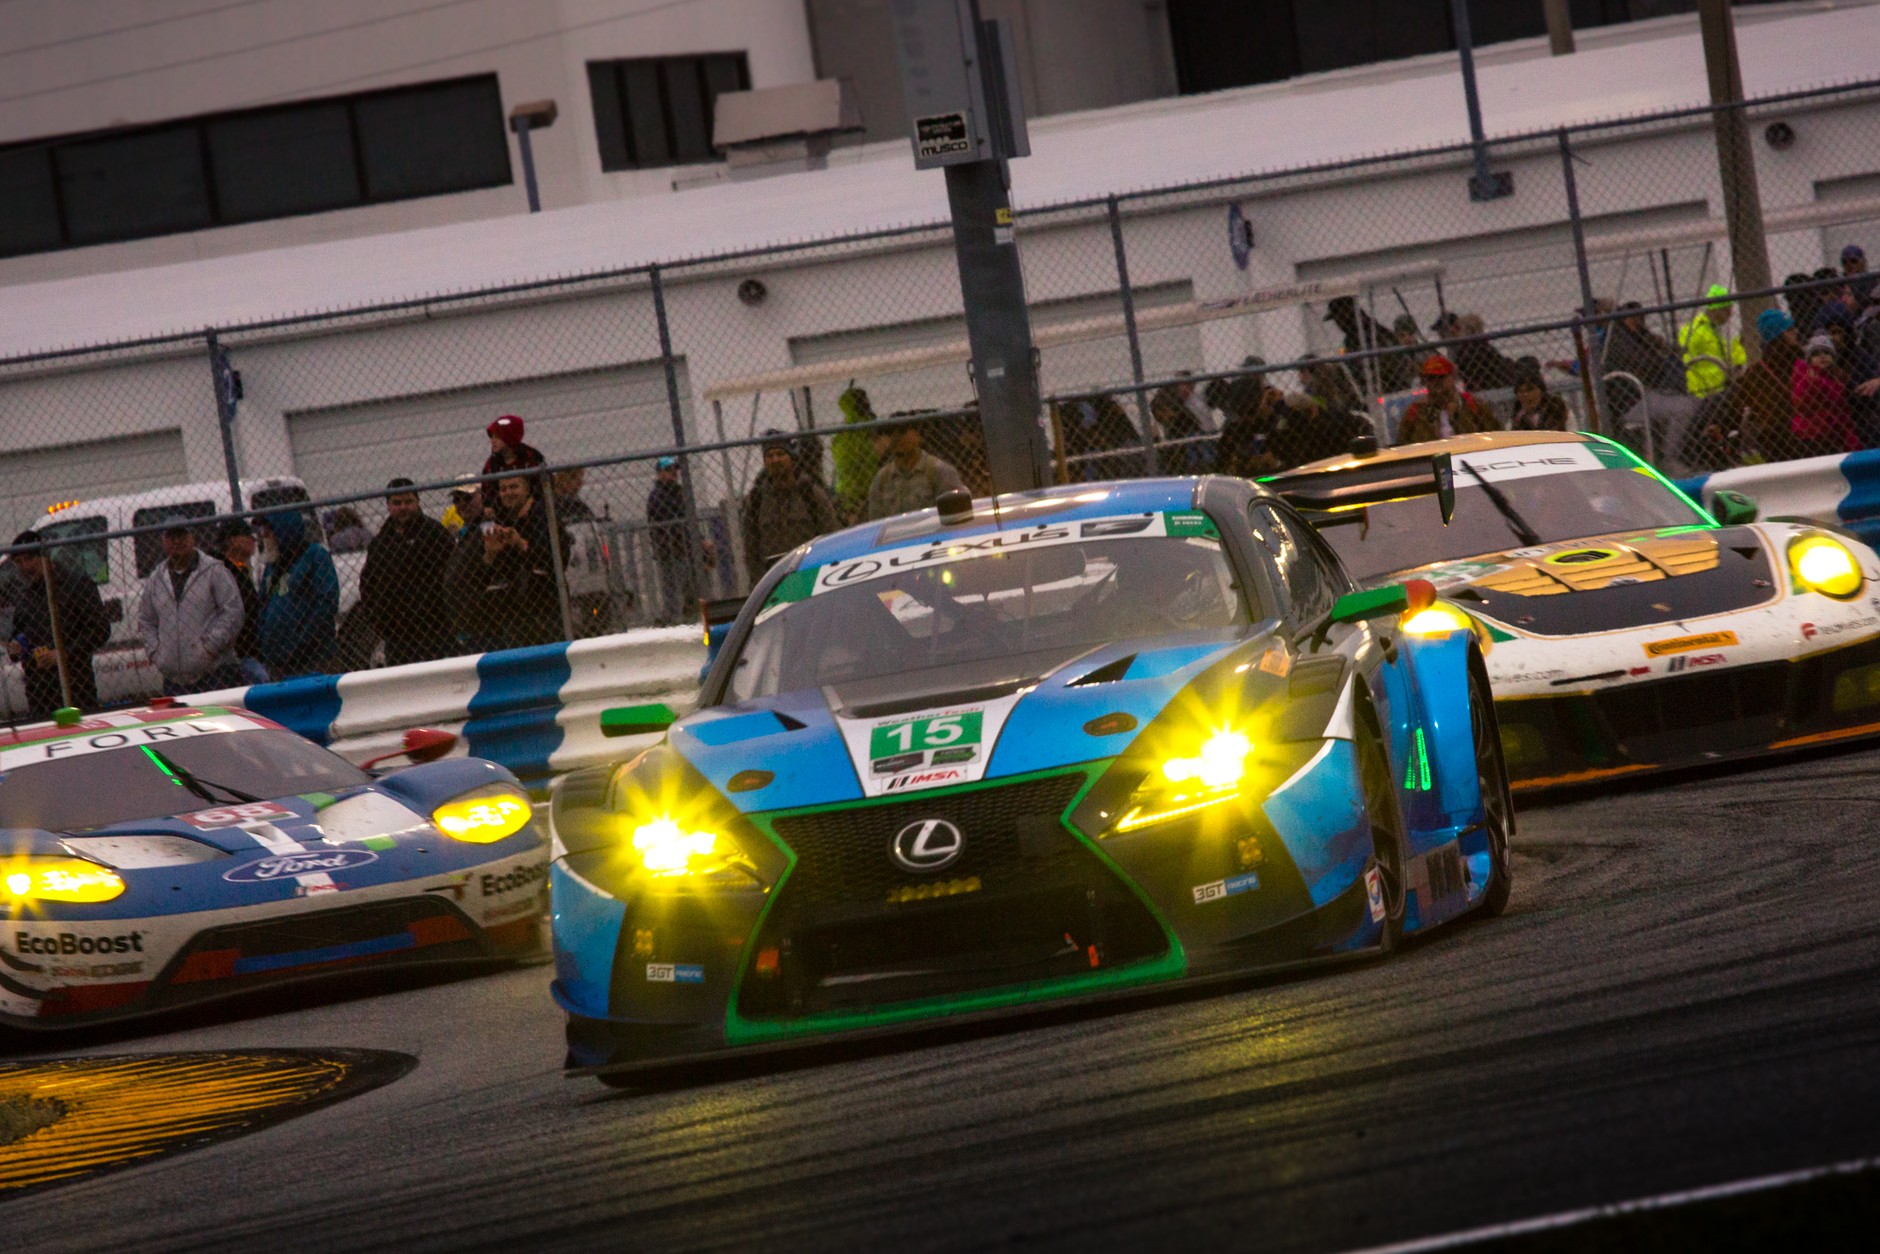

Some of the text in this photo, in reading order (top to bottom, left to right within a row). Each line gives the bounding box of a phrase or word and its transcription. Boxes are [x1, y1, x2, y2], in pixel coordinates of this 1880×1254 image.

[890, 529, 1070, 566] LEXUS
[887, 715, 963, 751] 15
[910, 770, 959, 785] IMSA
[255, 853, 349, 879] Ford
[1195, 883, 1224, 901] 3GT
[16, 930, 143, 955] EcoBoost
